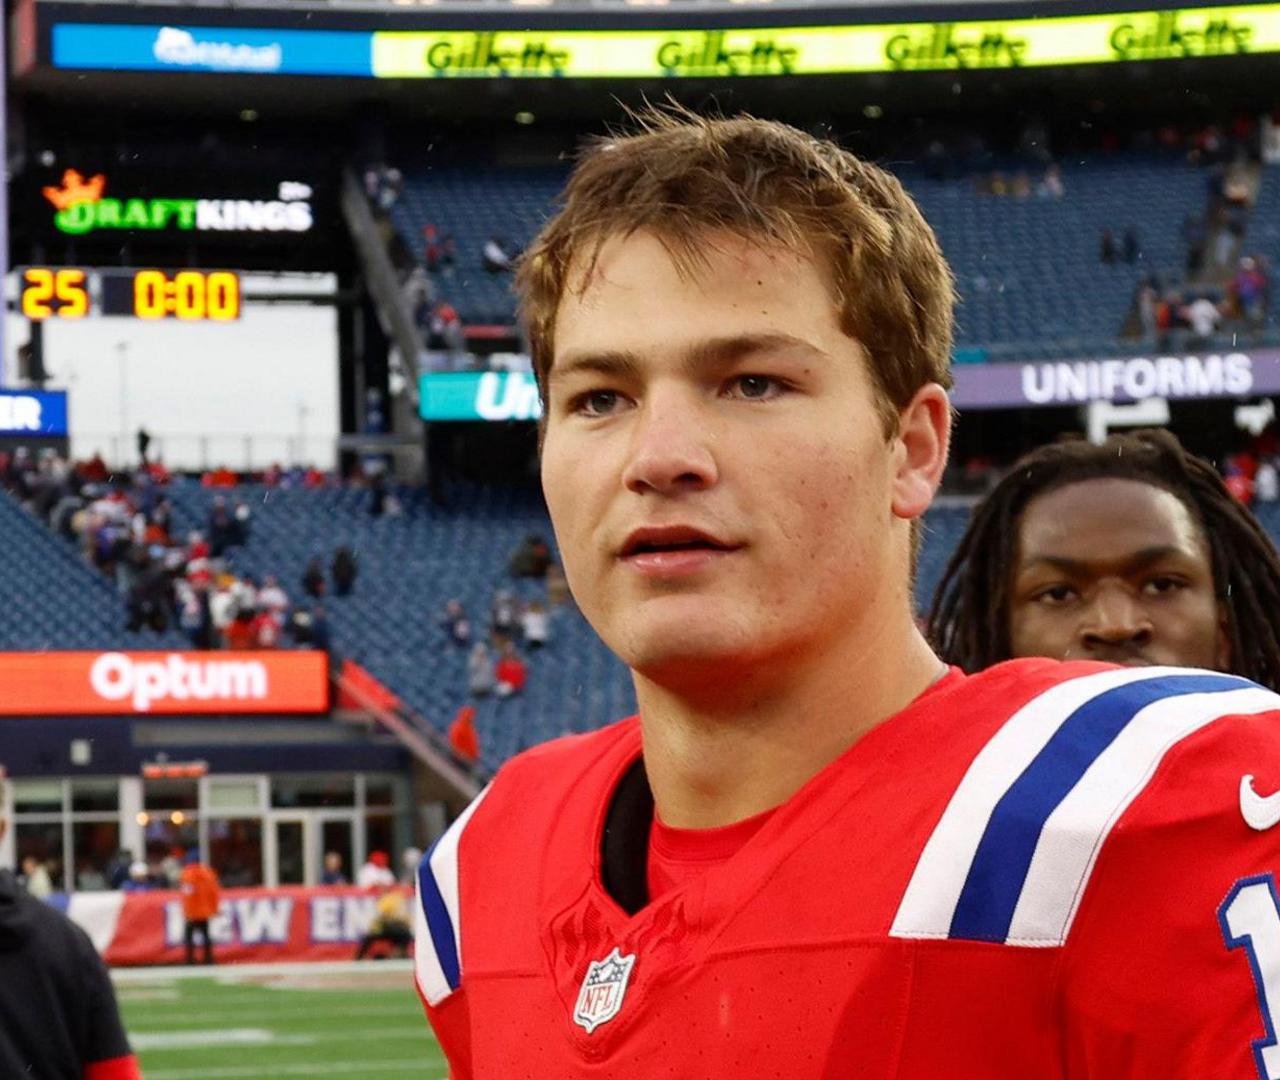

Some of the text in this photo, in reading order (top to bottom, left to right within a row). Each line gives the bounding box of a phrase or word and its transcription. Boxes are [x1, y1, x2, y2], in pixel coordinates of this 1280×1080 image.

[426, 32, 570, 73] Gillette
[657, 31, 798, 74] Gillette
[885, 23, 1026, 69] Gillette
[1110, 11, 1253, 57] Gillette
[54, 198, 313, 234] DRAFTKINGS
[22, 268, 88, 318] 25
[133, 270, 240, 320] 0:00
[1021, 353, 1252, 402] UNIFORMS
[90, 652, 268, 712] Optum
